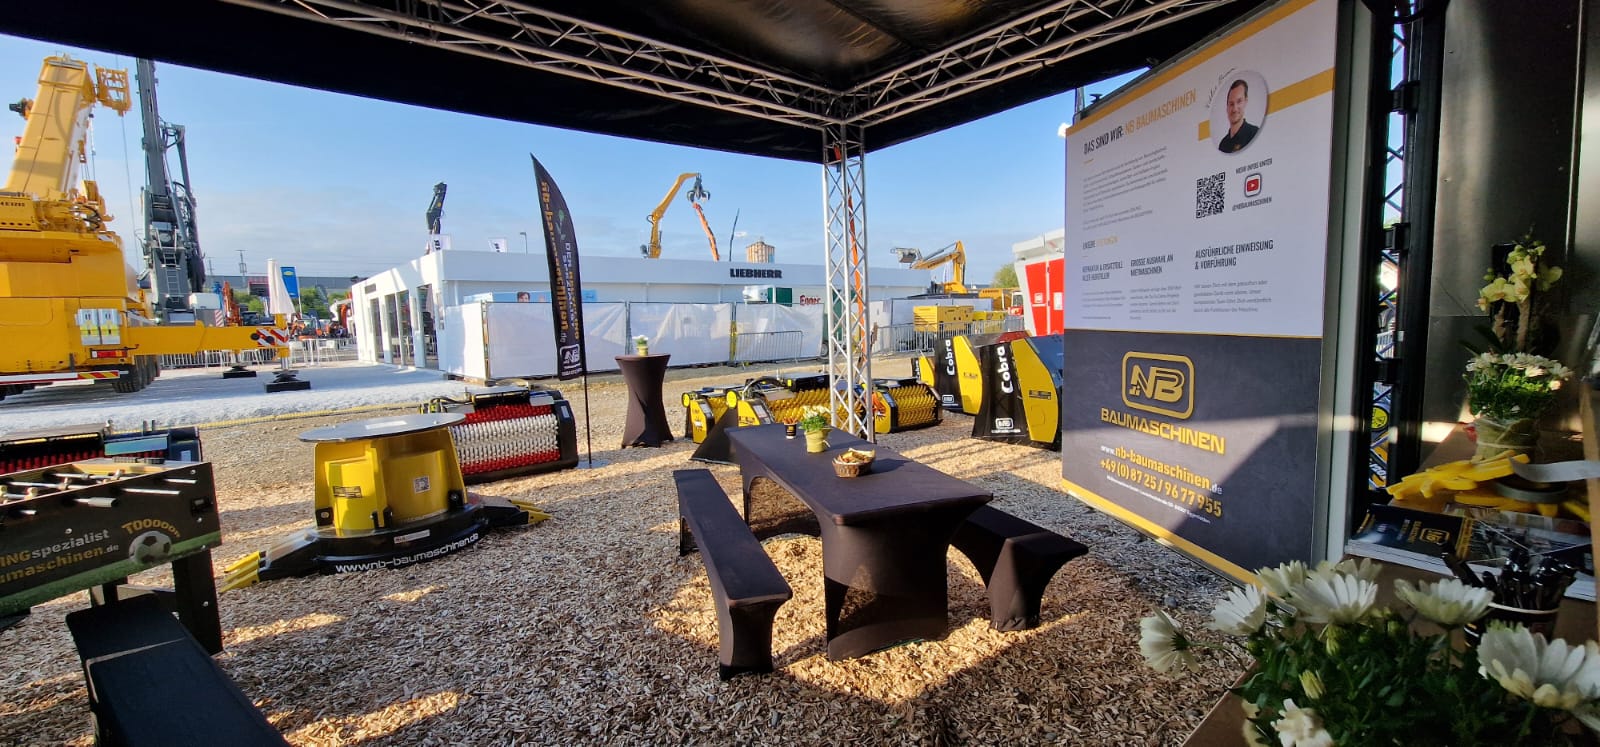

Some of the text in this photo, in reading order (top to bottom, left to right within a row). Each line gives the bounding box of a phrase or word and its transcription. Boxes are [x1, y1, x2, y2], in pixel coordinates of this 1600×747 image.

[1083, 142, 1095, 155] DAS
[1095, 132, 1109, 150] SIND
[1136, 88, 1196, 130] BAUMASCHINEN
[1195, 239, 1274, 259] AUSFÜHRLICHE EINWEISUNG
[1200, 256, 1237, 270] VORFÜHRUNG
[730, 268, 782, 279] LIEBHERR
[945, 339, 955, 376] Cobra
[996, 345, 1014, 394] Cobra
[1129, 365, 1185, 403] NB
[1101, 407, 1225, 455] BAUMASCHINEN
[1101, 445, 1222, 495] www.nb-baumaschinen.de
[1101, 458, 1116, 473] +49
[1117, 462, 1129, 480] (0)
[1130, 468, 1142, 483] 87
[1143, 474, 1157, 490] 25
[1164, 482, 1179, 499] 96
[1180, 487, 1195, 506] 77
[1197, 494, 1222, 518] 955
